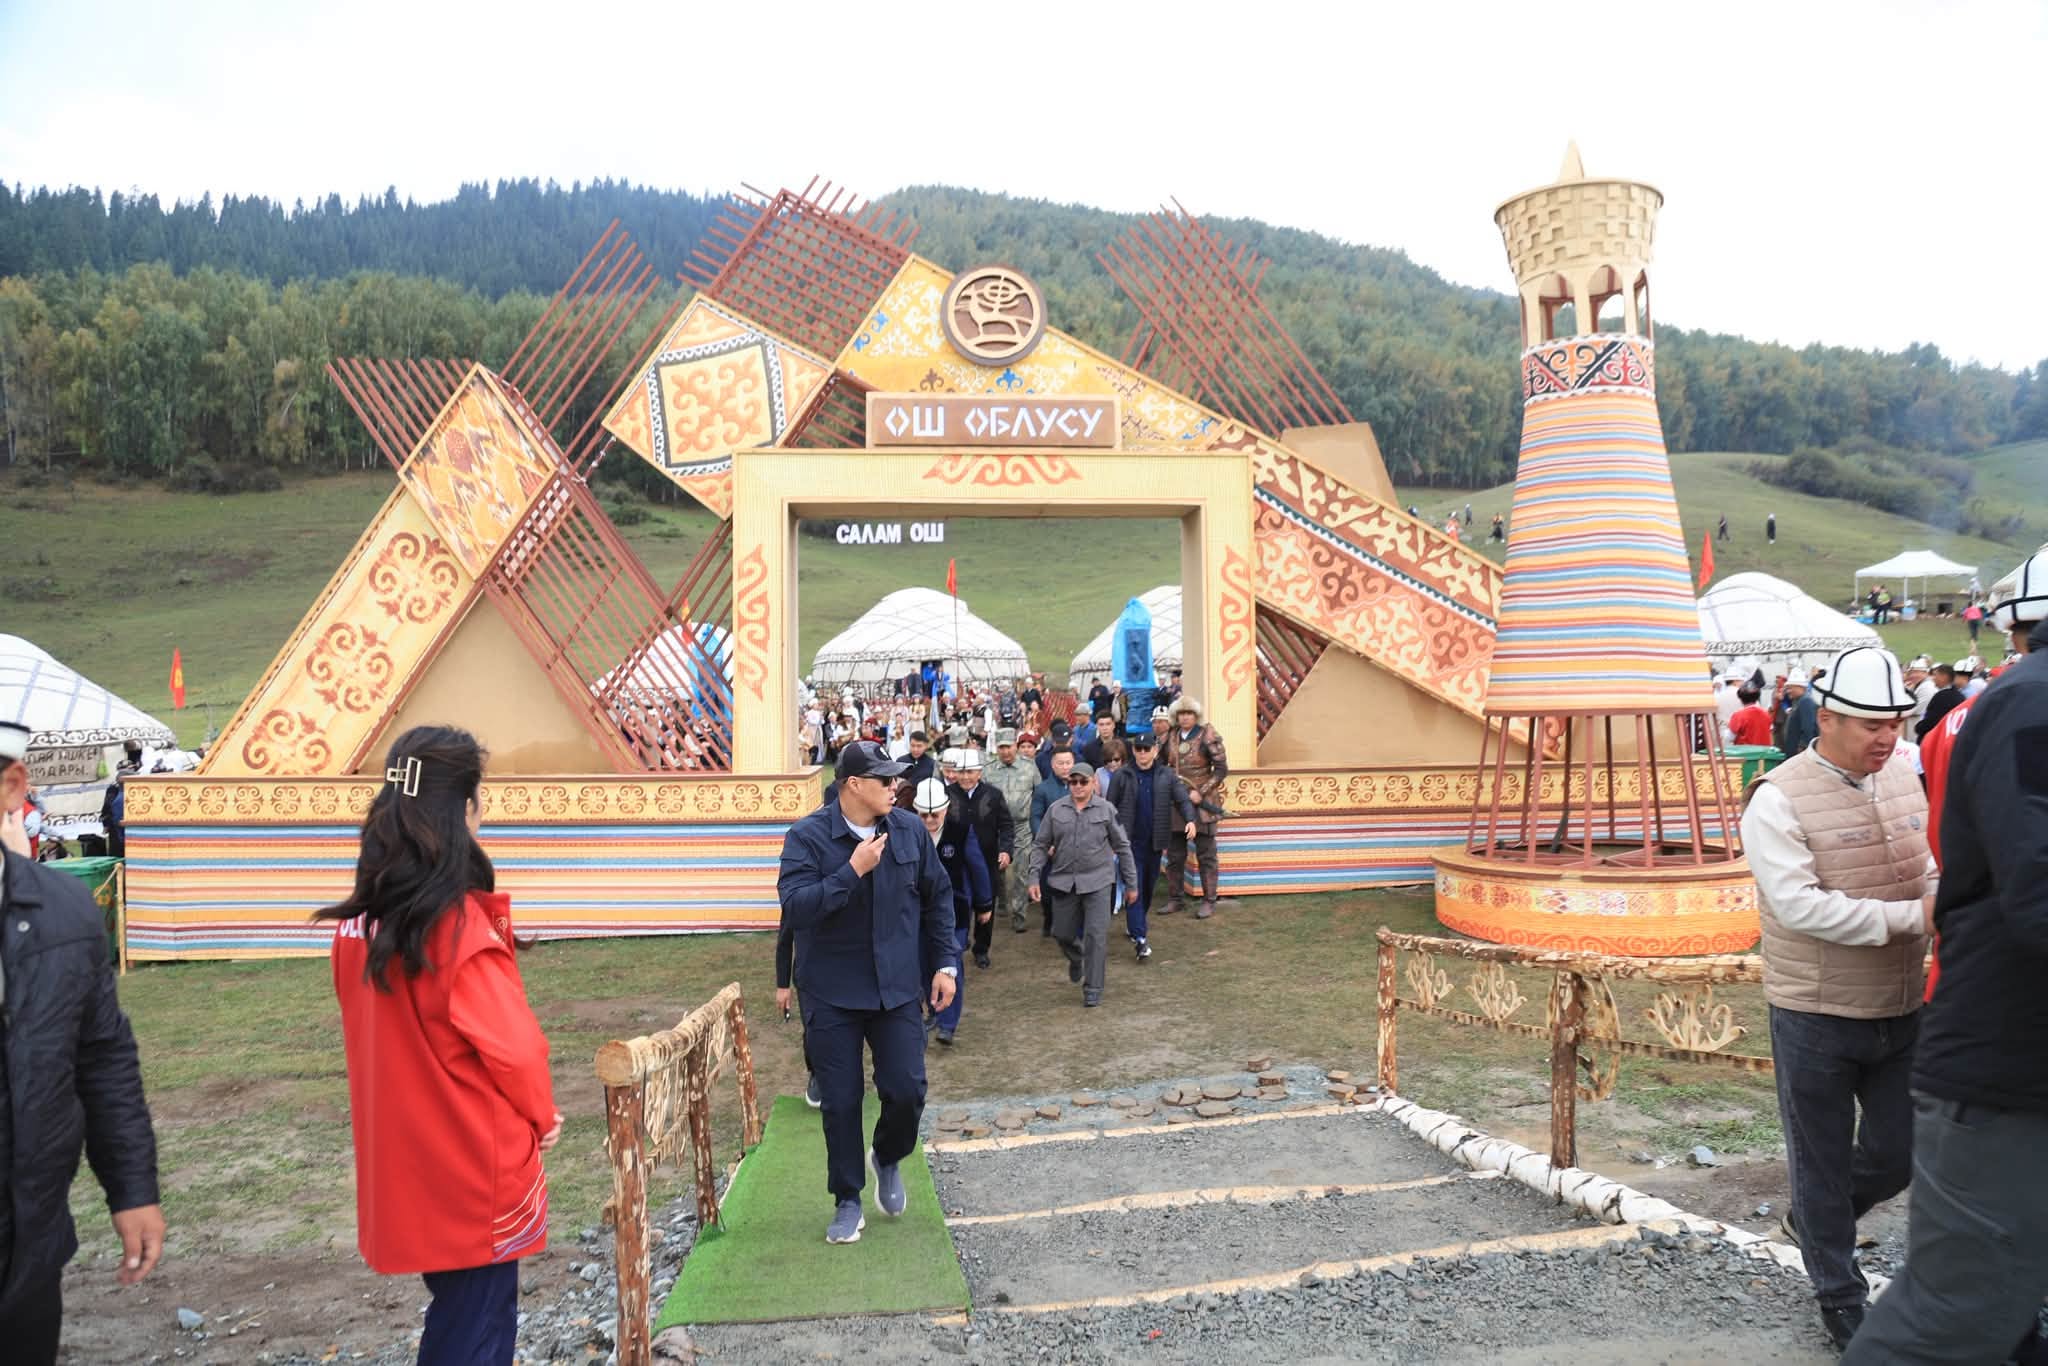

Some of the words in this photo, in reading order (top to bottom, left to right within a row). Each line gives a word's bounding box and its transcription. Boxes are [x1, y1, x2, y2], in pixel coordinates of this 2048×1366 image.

[884, 406, 945, 437] ОШ
[964, 407, 1103, 437] ОБЛУСУ
[836, 523, 902, 544] САЛАМ
[910, 522, 944, 542] ОШ
